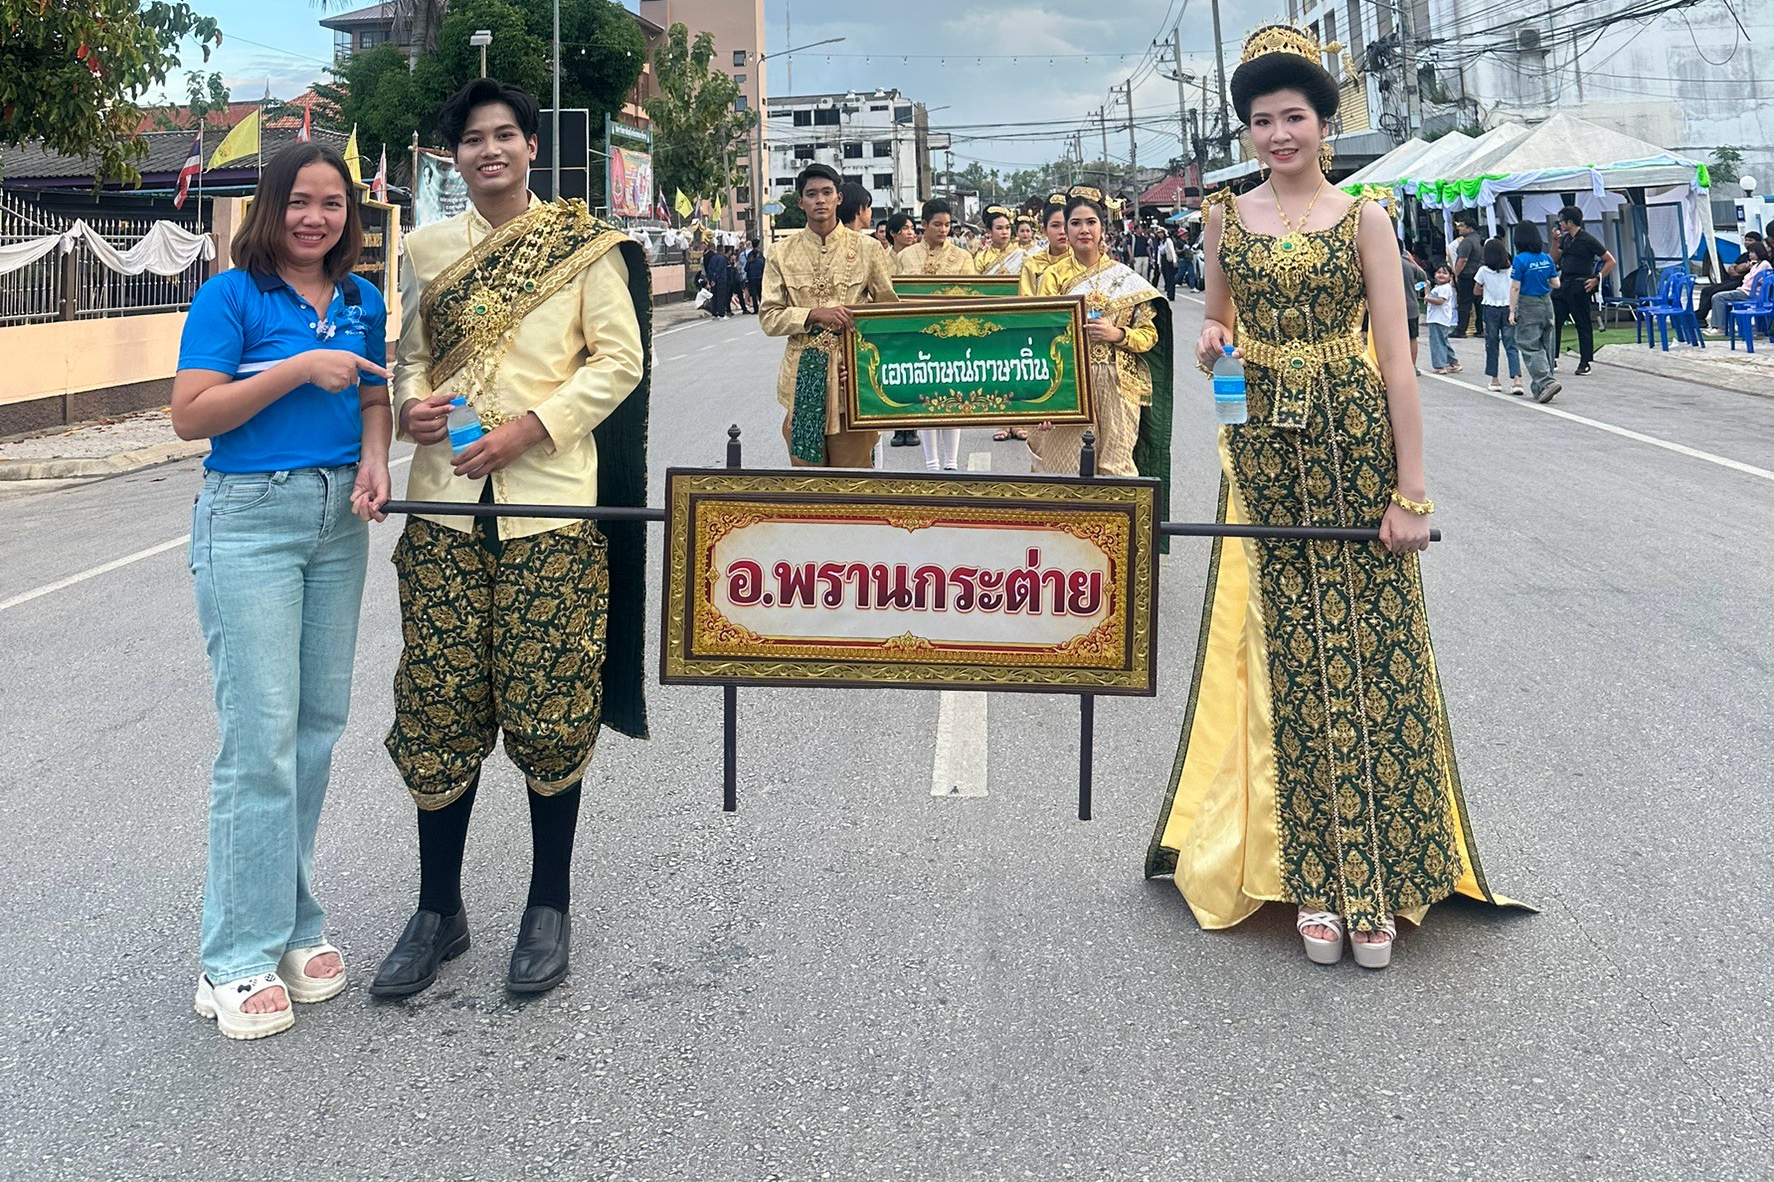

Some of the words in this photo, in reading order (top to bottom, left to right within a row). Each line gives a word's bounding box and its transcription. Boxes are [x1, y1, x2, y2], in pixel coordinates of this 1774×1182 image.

[881, 336, 1050, 386] เอกลักษณ์ภาษาถิ่น
[727, 548, 1102, 615] อ.พรานกระต่าย
